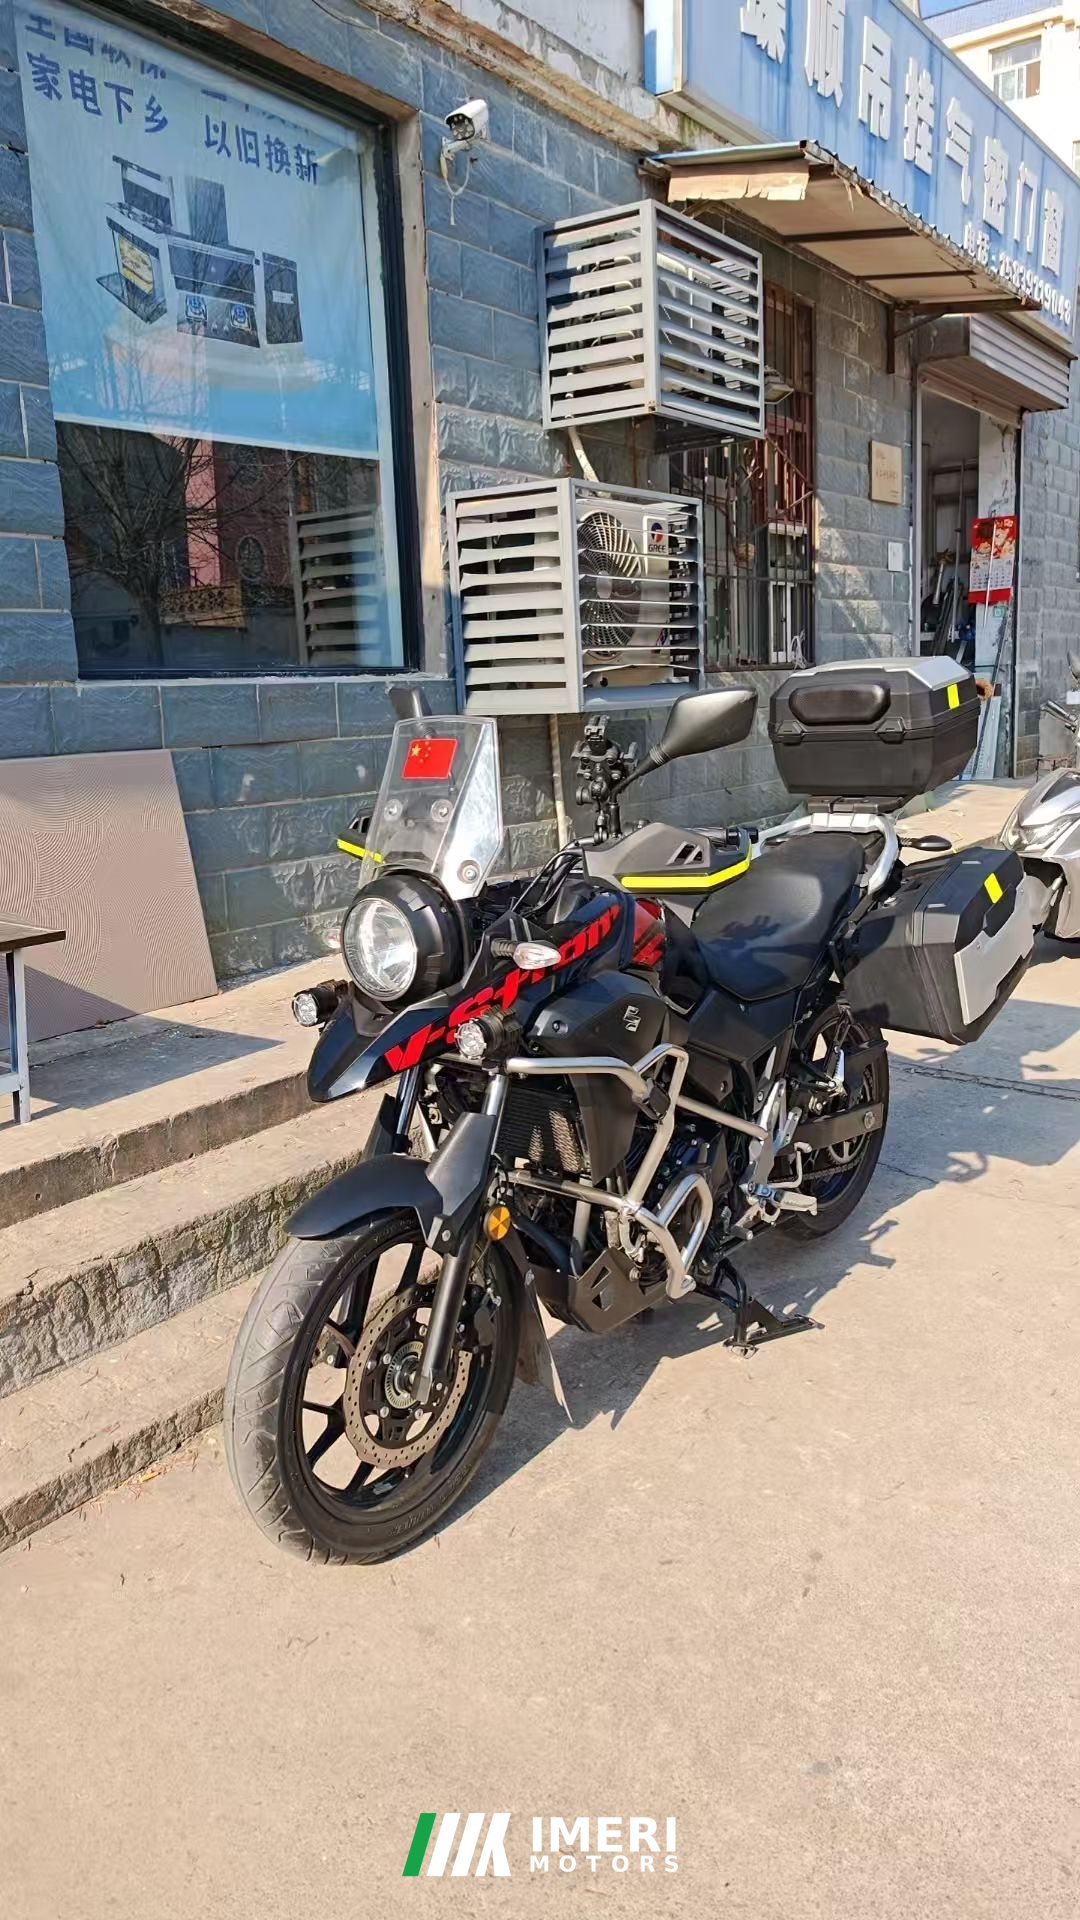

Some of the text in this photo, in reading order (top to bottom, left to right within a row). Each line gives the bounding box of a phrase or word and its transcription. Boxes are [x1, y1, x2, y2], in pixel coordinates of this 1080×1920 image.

[26, 51, 169, 134] 家电下乡
[204, 114, 318, 185] 以旧换新
[648, 544, 667, 553] GREE
